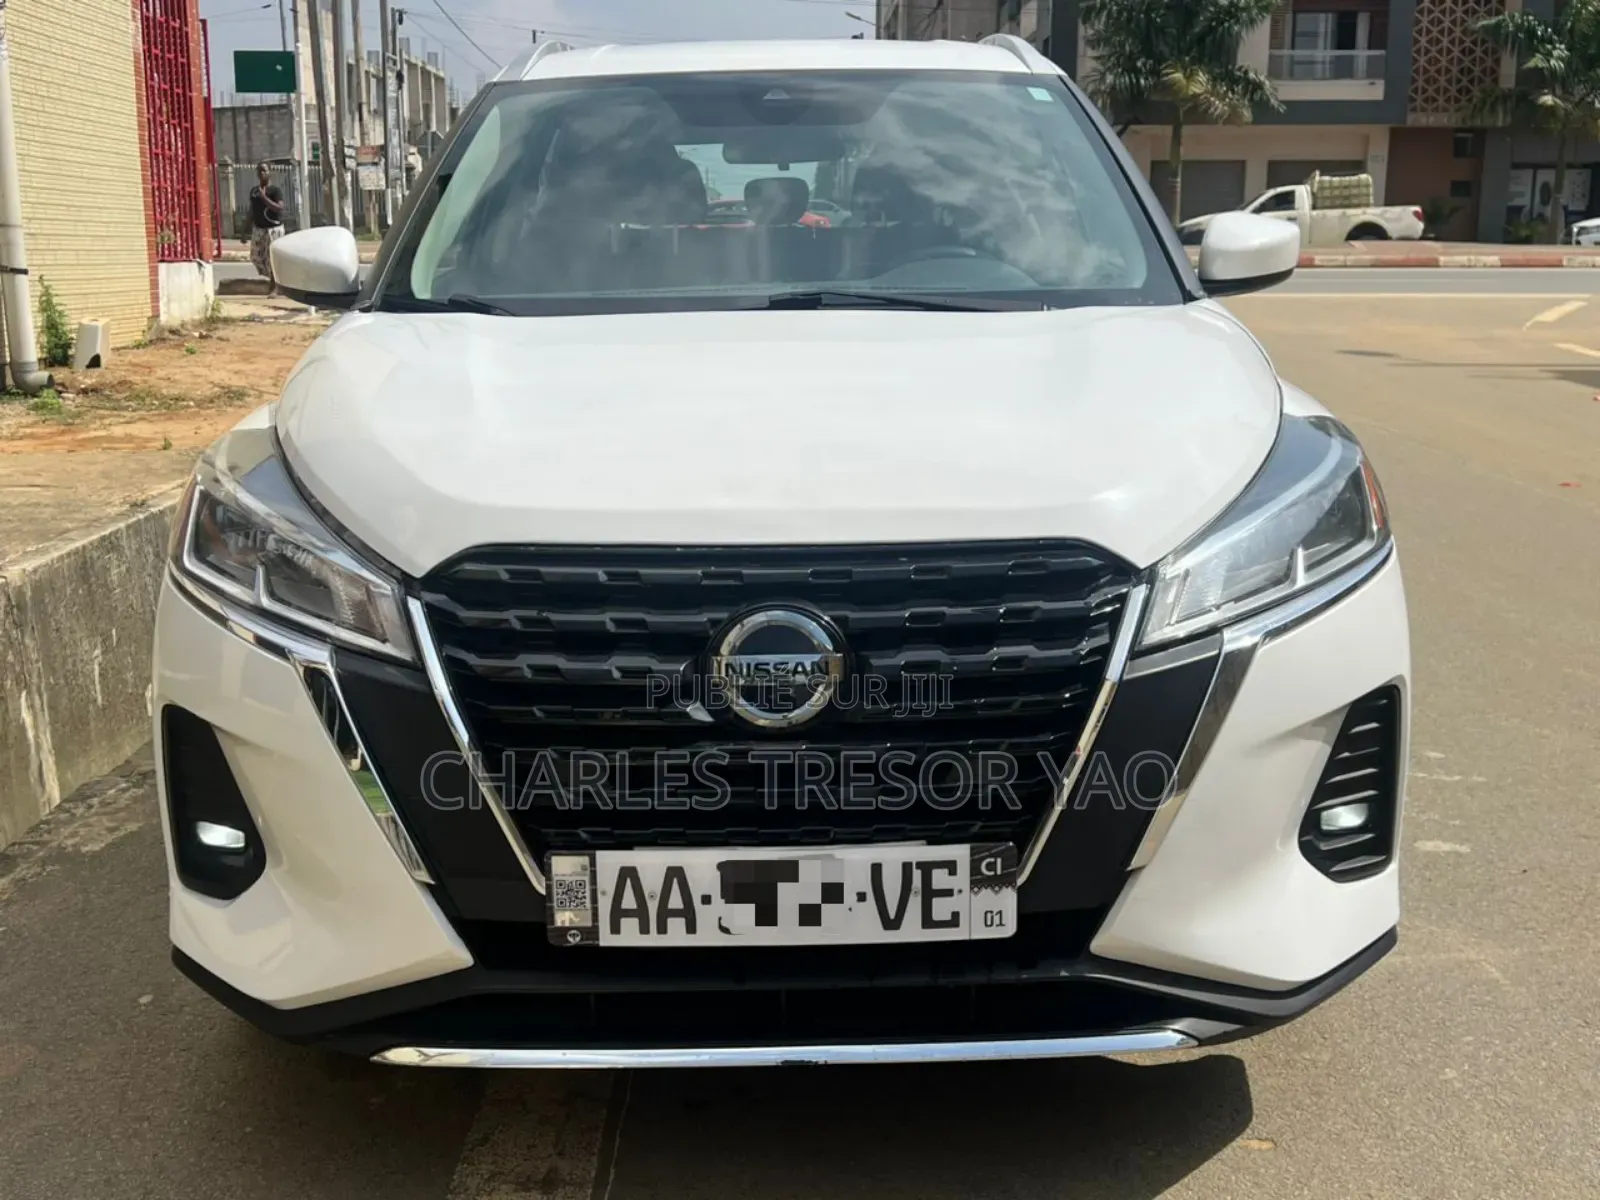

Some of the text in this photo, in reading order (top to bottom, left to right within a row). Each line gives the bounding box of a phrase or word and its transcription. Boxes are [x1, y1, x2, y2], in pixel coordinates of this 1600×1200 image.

[724, 660, 830, 678] NISSAN
[980, 857, 1003, 876] CI
[983, 909, 1006, 928] 01
